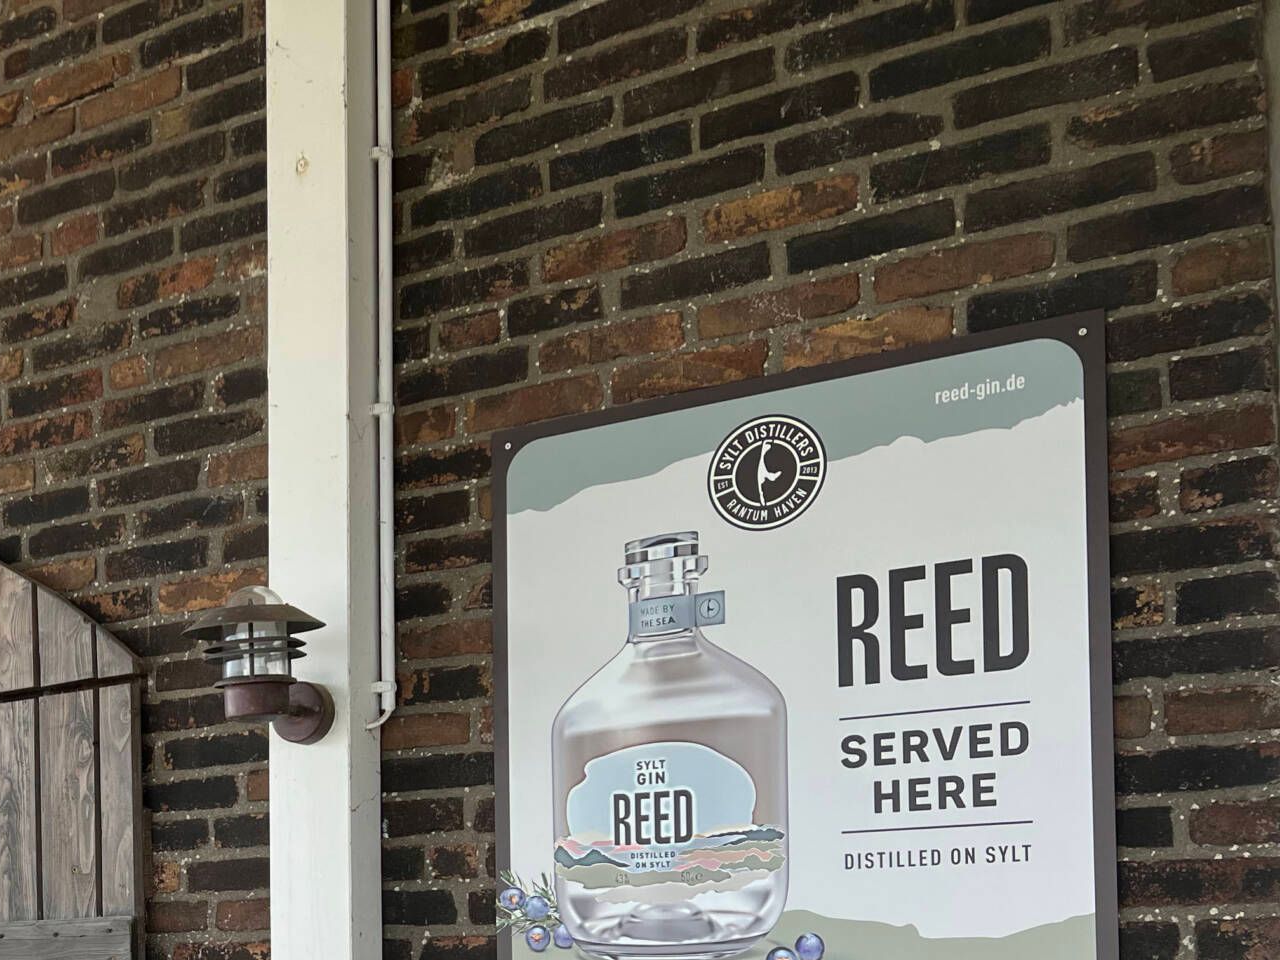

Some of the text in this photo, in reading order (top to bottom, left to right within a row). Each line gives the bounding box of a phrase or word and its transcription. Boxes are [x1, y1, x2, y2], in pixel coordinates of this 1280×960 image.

[935, 374, 1026, 405] reed-gin.de
[720, 424, 814, 470] SYLT DISTILLERS
[717, 480, 729, 490] EST
[726, 487, 808, 521] RANTUM HAVEN
[641, 616, 676, 628] THE SEA
[662, 603, 675, 614] BY
[836, 552, 1031, 688] REED
[840, 721, 1031, 769] SERVED
[636, 760, 666, 770] SYLT
[637, 771, 666, 785] GIN
[873, 772, 998, 814] HERE
[613, 789, 694, 846] REED
[630, 851, 676, 860] DISTILLED
[650, 861, 671, 869] SYLT
[844, 844, 1033, 871] DISTILLED ON SYLT
